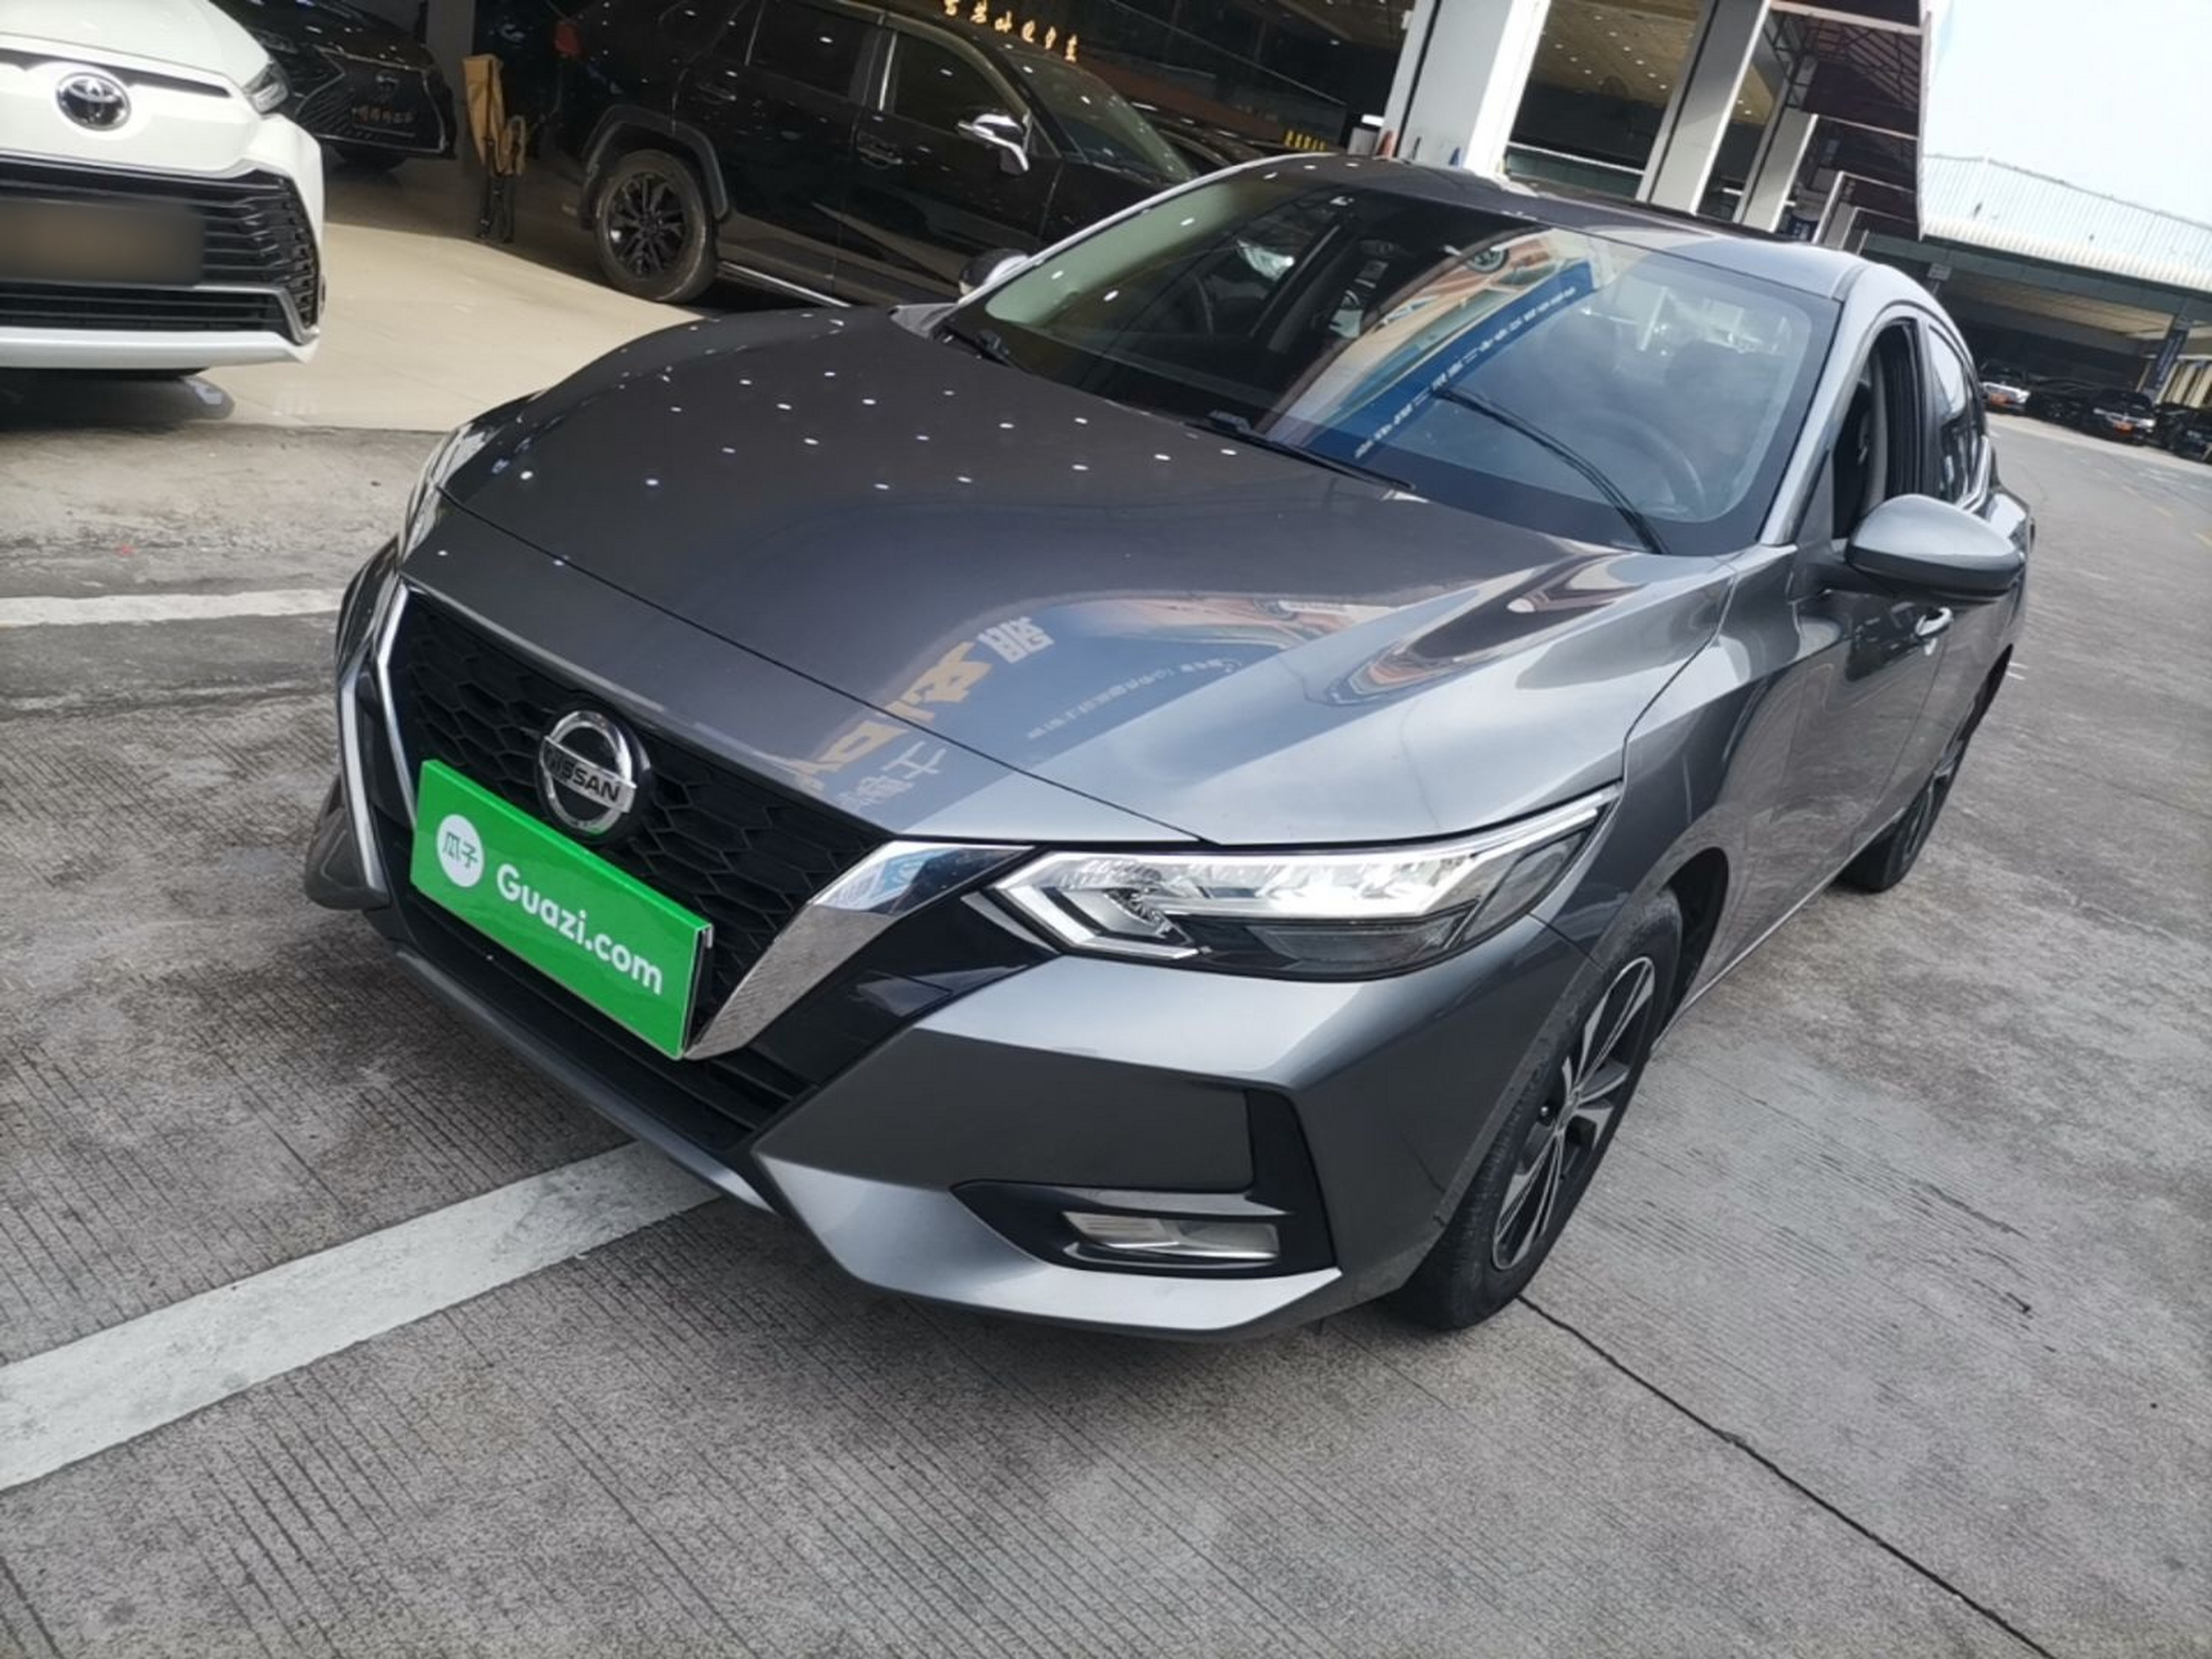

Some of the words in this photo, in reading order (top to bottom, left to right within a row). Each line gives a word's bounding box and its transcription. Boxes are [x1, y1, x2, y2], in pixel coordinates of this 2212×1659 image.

[546, 748, 622, 804] NISSAN
[442, 831, 479, 869] 瓜子
[497, 863, 662, 995] Guazi.com
